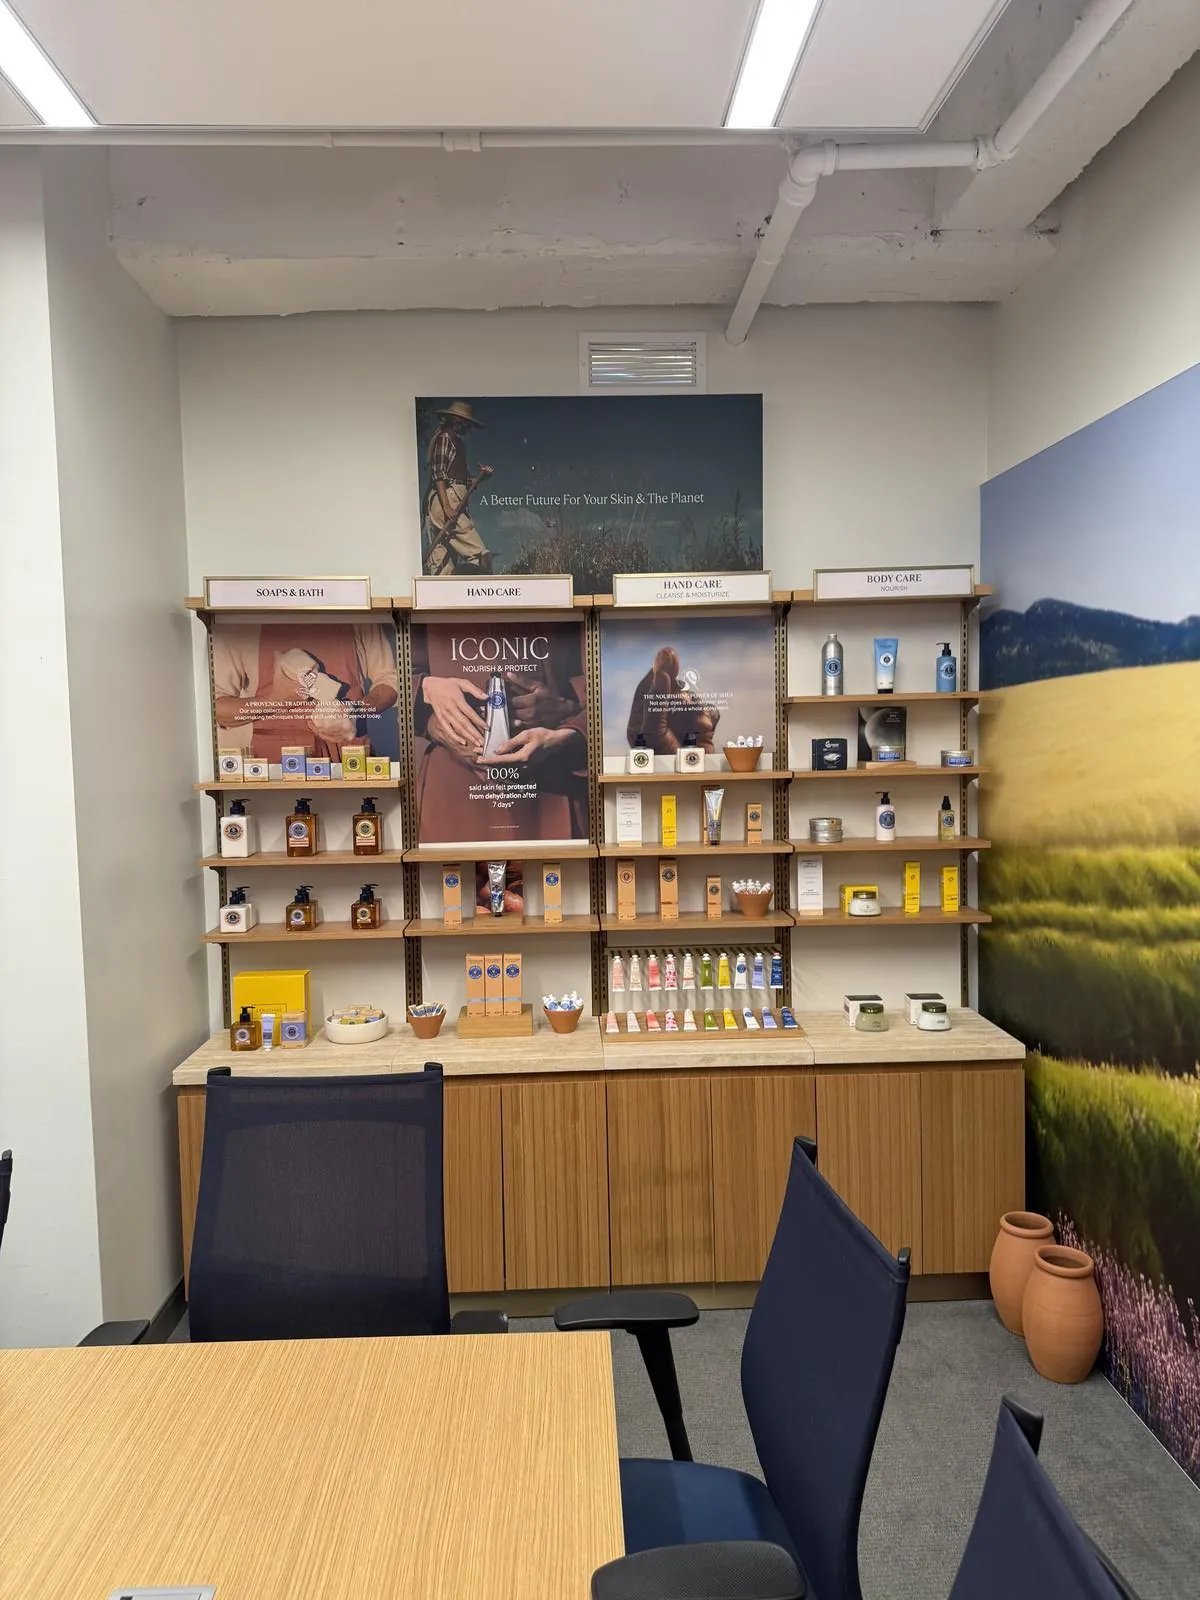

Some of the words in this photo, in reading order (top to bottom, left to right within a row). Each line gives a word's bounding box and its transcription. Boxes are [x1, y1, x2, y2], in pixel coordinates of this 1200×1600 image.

[479, 495, 489, 506] A
[491, 494, 524, 506] Better
[526, 494, 561, 506] Future
[563, 494, 582, 505] For
[583, 493, 608, 505] Your
[610, 493, 634, 505] Skin
[635, 492, 646, 504] &
[647, 492, 669, 504] The
[671, 491, 705, 504] Planet
[867, 574, 894, 583] BODY
[895, 573, 922, 583] CARE
[664, 580, 693, 589] HAND
[694, 579, 722, 589] CARE
[256, 588, 288, 597] SOAPS
[289, 588, 297, 597] &
[298, 588, 324, 597] BATH
[467, 588, 495, 596] HAND
[495, 587, 521, 596] CARE
[449, 636, 550, 661] ICONIC
[462, 664, 496, 673] NOURISH
[496, 664, 503, 672] &
[504, 663, 538, 672] PROTECT
[486, 767, 520, 780] 100%
[468, 783, 482, 791] said
[482, 783, 495, 791] skin
[507, 782, 537, 791] protected
[469, 792, 485, 800] from
[485, 791, 522, 801] dehydration
[522, 791, 537, 799] after
